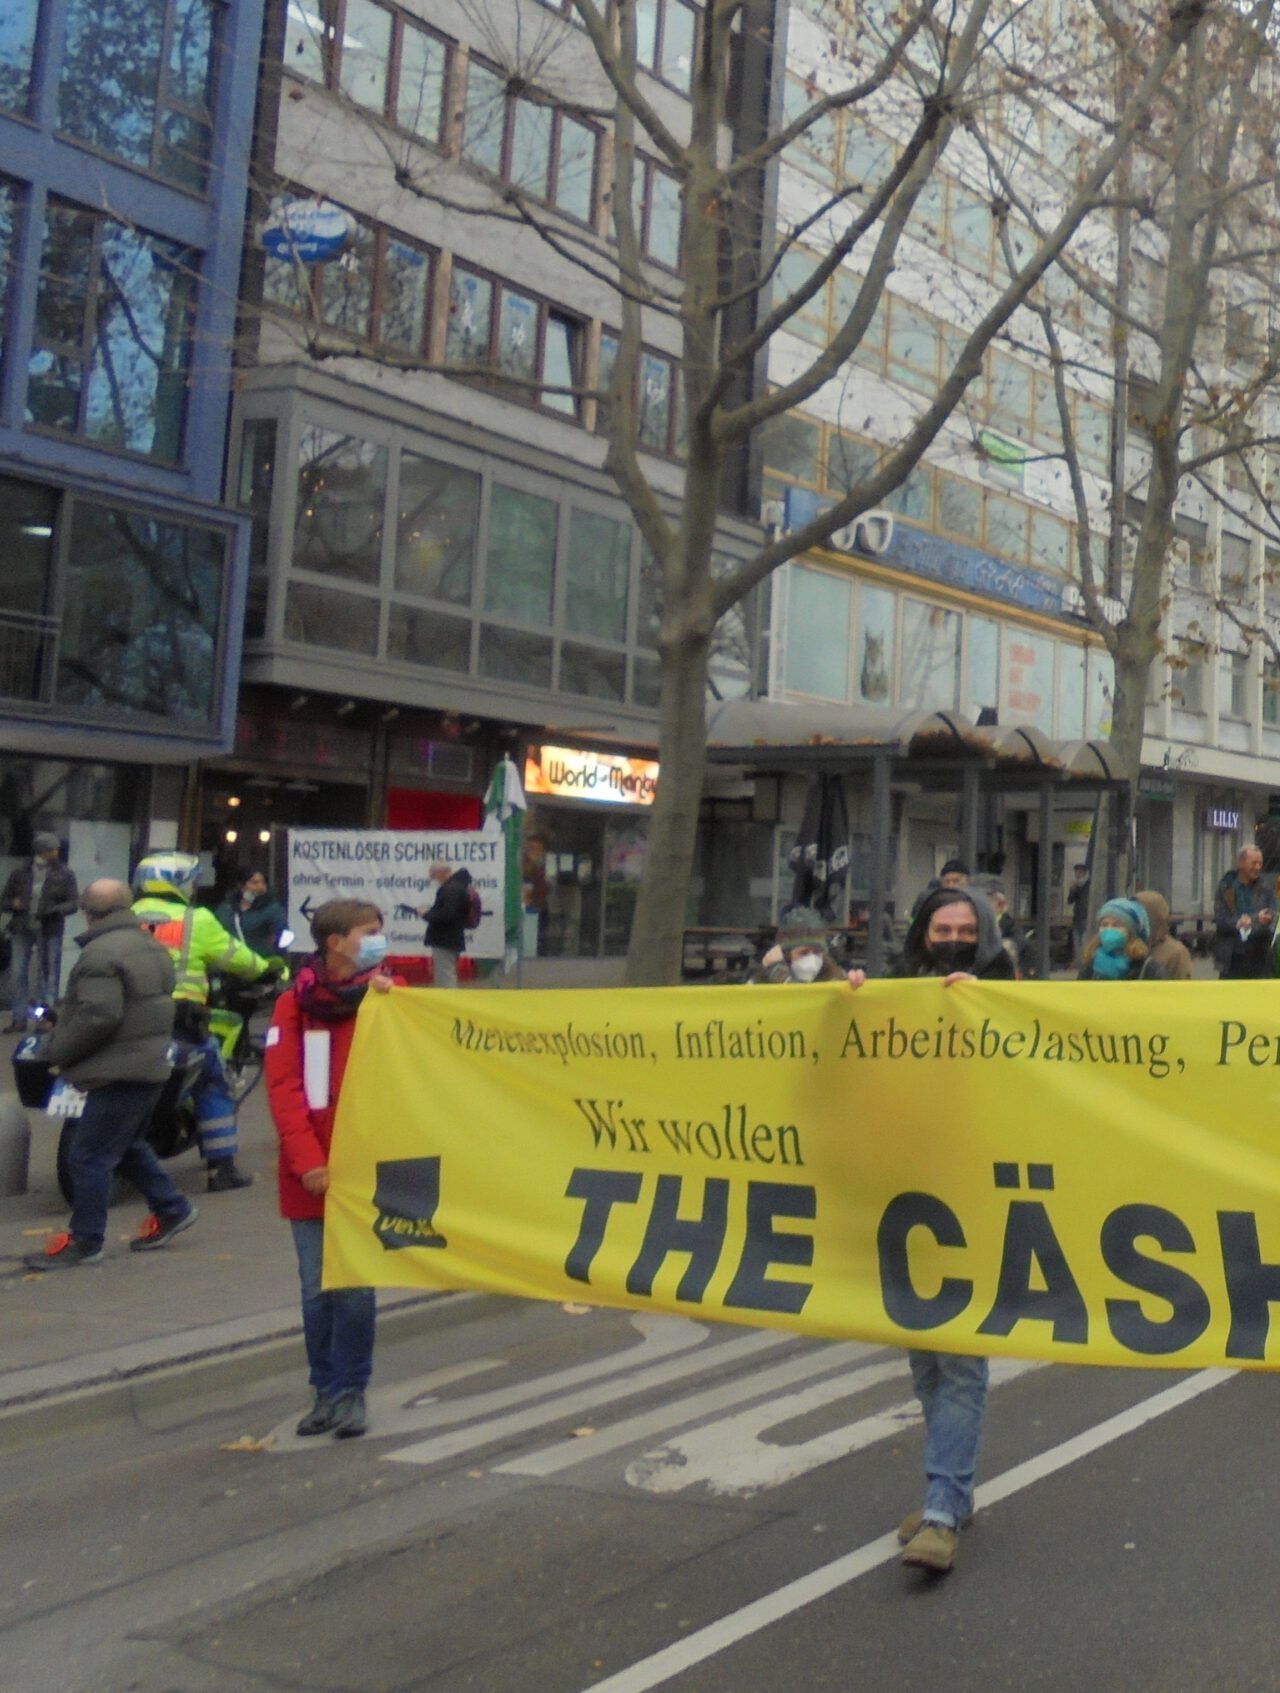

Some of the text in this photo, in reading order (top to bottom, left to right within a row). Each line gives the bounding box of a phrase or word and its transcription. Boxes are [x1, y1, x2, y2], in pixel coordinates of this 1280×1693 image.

[1213, 809, 1239, 829] LILLY
[293, 840, 497, 862] KOSTENLOSER SCHNELLTEST
[16, 1036, 37, 1060] 2
[674, 1019, 819, 1065] Inflation,
[839, 1016, 1186, 1079] Arbeitsbelastung,
[573, 1098, 805, 1167] Wir wollen
[564, 1167, 818, 1315] THE
